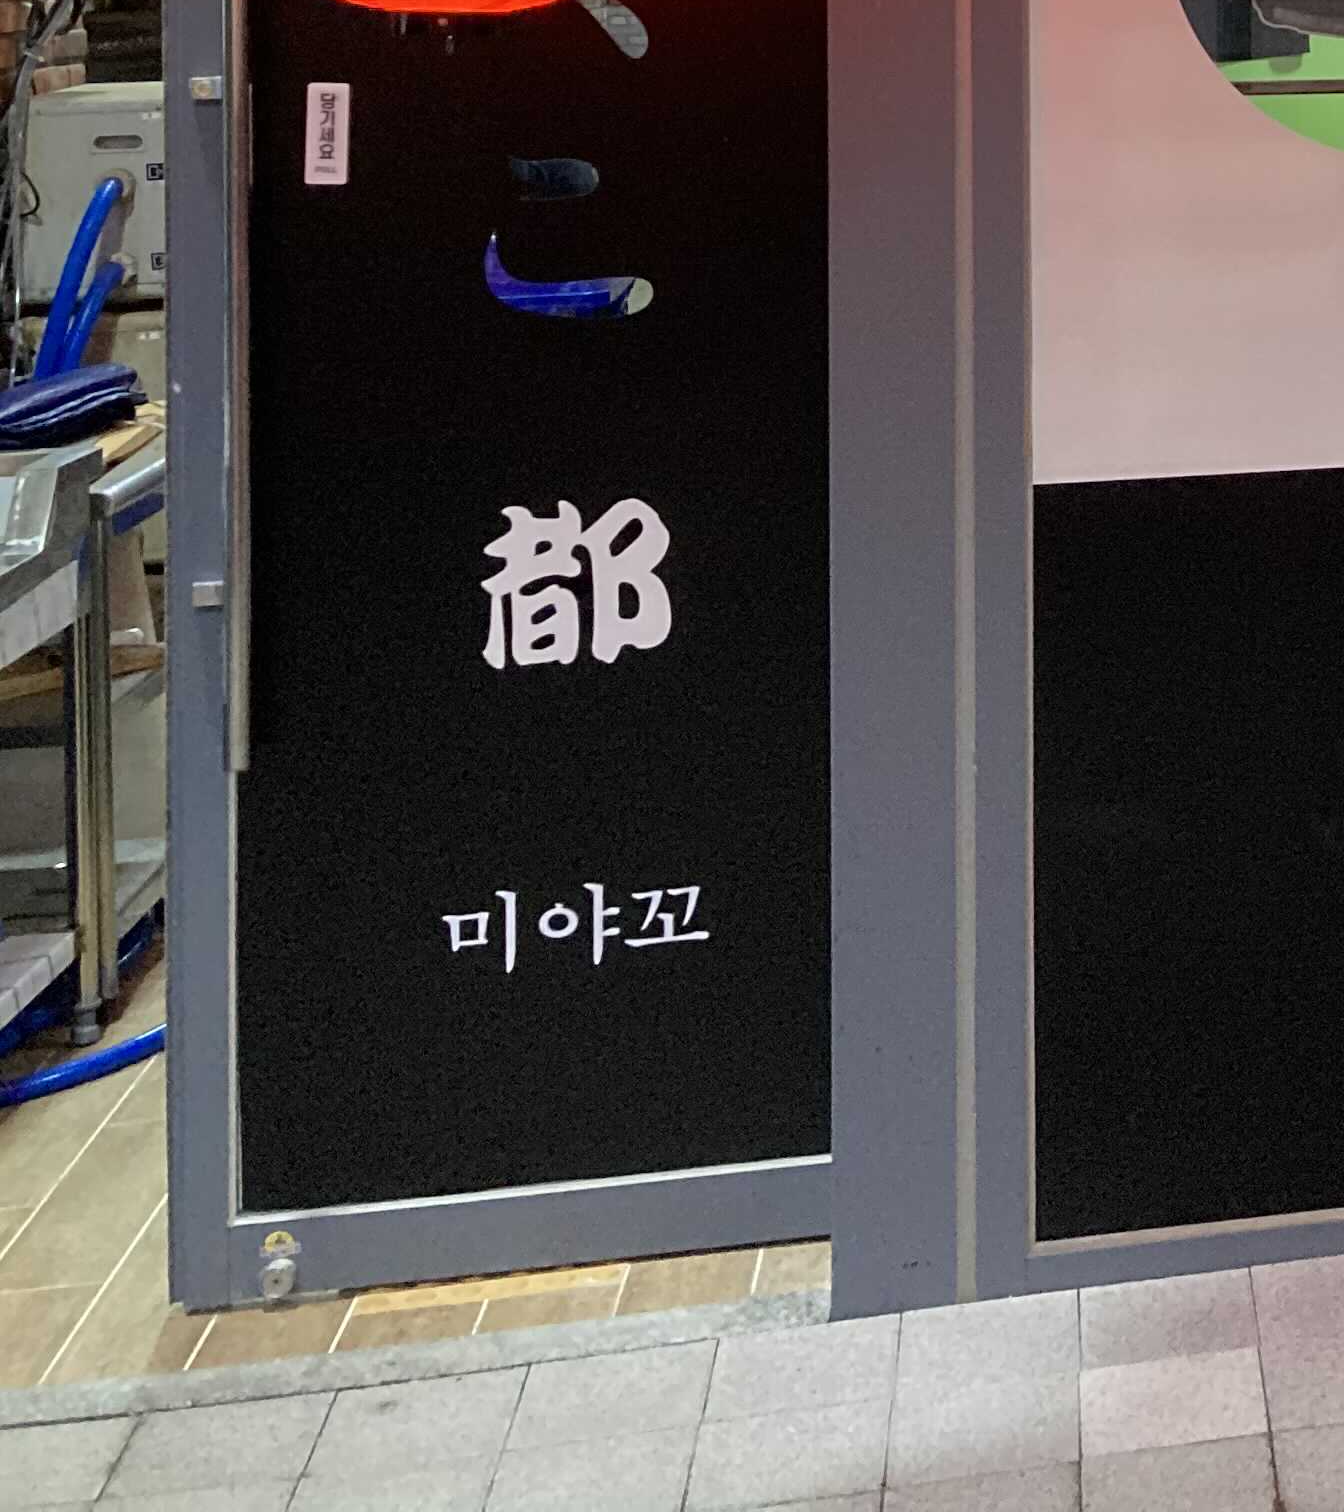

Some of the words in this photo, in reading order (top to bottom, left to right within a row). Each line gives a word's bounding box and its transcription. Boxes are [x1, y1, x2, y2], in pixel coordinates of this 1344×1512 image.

[318, 92, 336, 160] 당기세요
[481, 497, 672, 670] 都
[442, 882, 710, 974] 미야꼬
